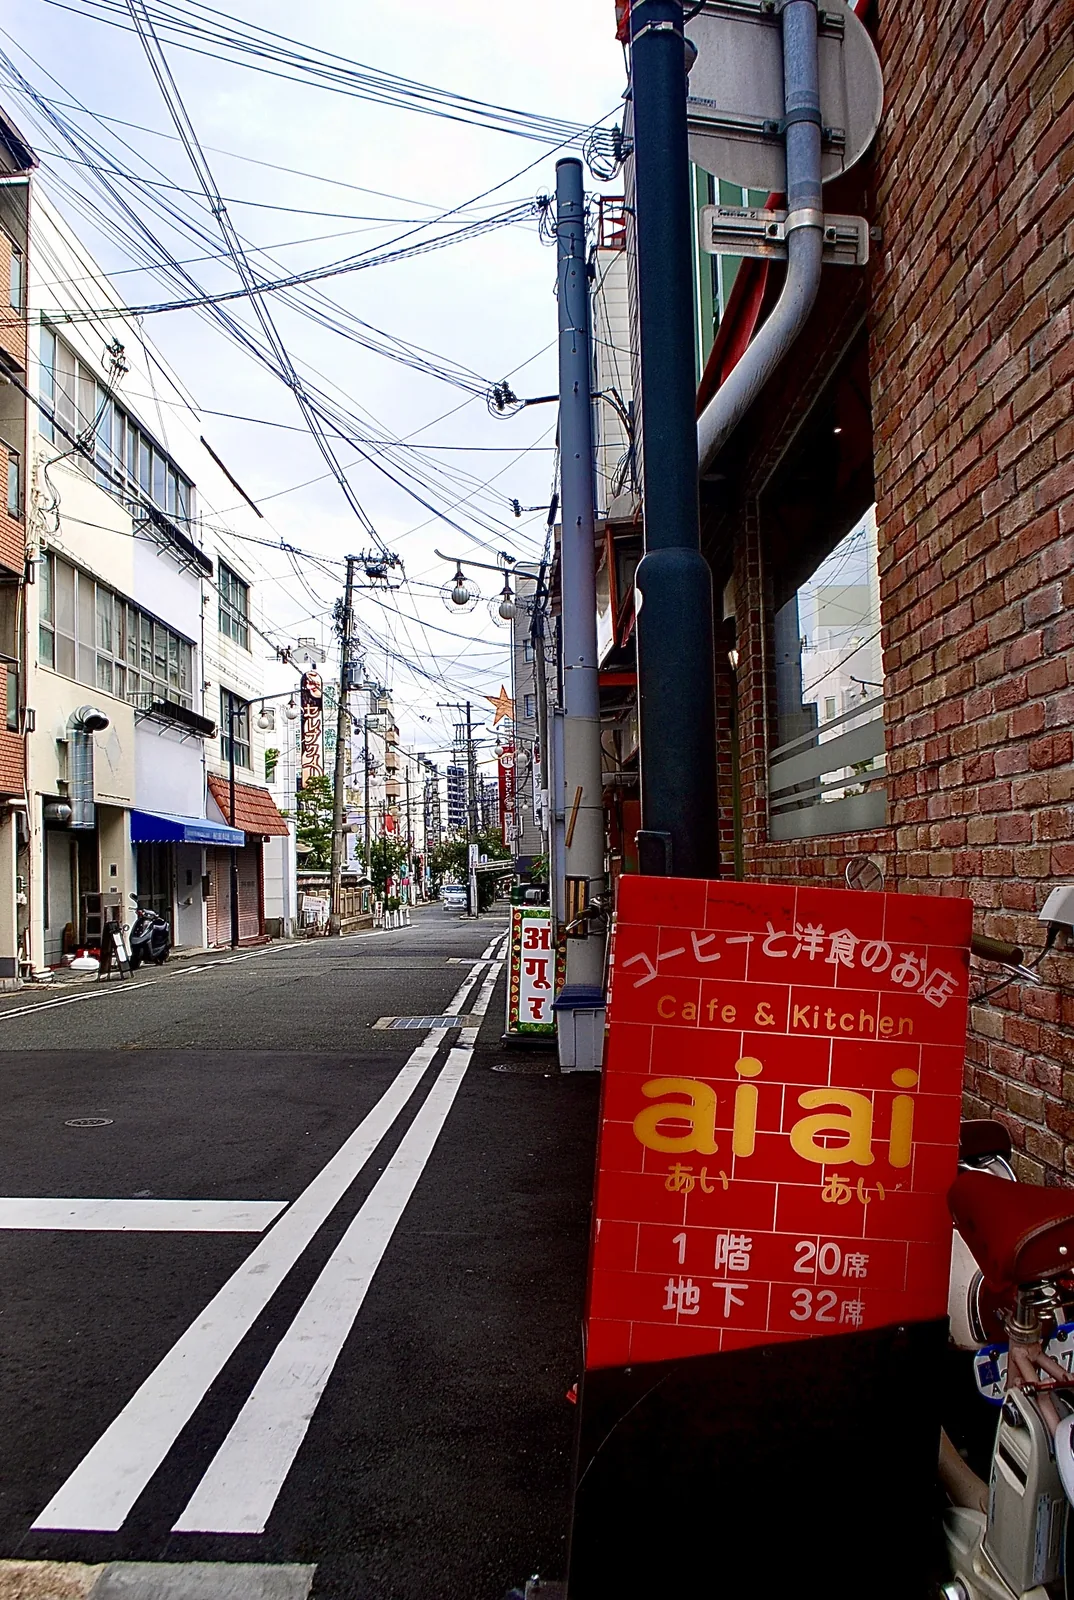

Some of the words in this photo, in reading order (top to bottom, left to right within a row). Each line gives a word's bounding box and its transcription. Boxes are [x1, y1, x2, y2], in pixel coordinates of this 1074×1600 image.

[622, 921, 960, 1008] コーヒーと洋食のお店
[657, 995, 737, 1023] Cafe
[754, 1001, 775, 1025] &
[793, 1005, 914, 1036] Kitchen
[664, 1162, 729, 1194] あい
[821, 1173, 885, 1205] あい
[794, 1240, 870, 1279] 20席
[662, 1278, 749, 1318] 地下
[790, 1288, 866, 1327] 32席
